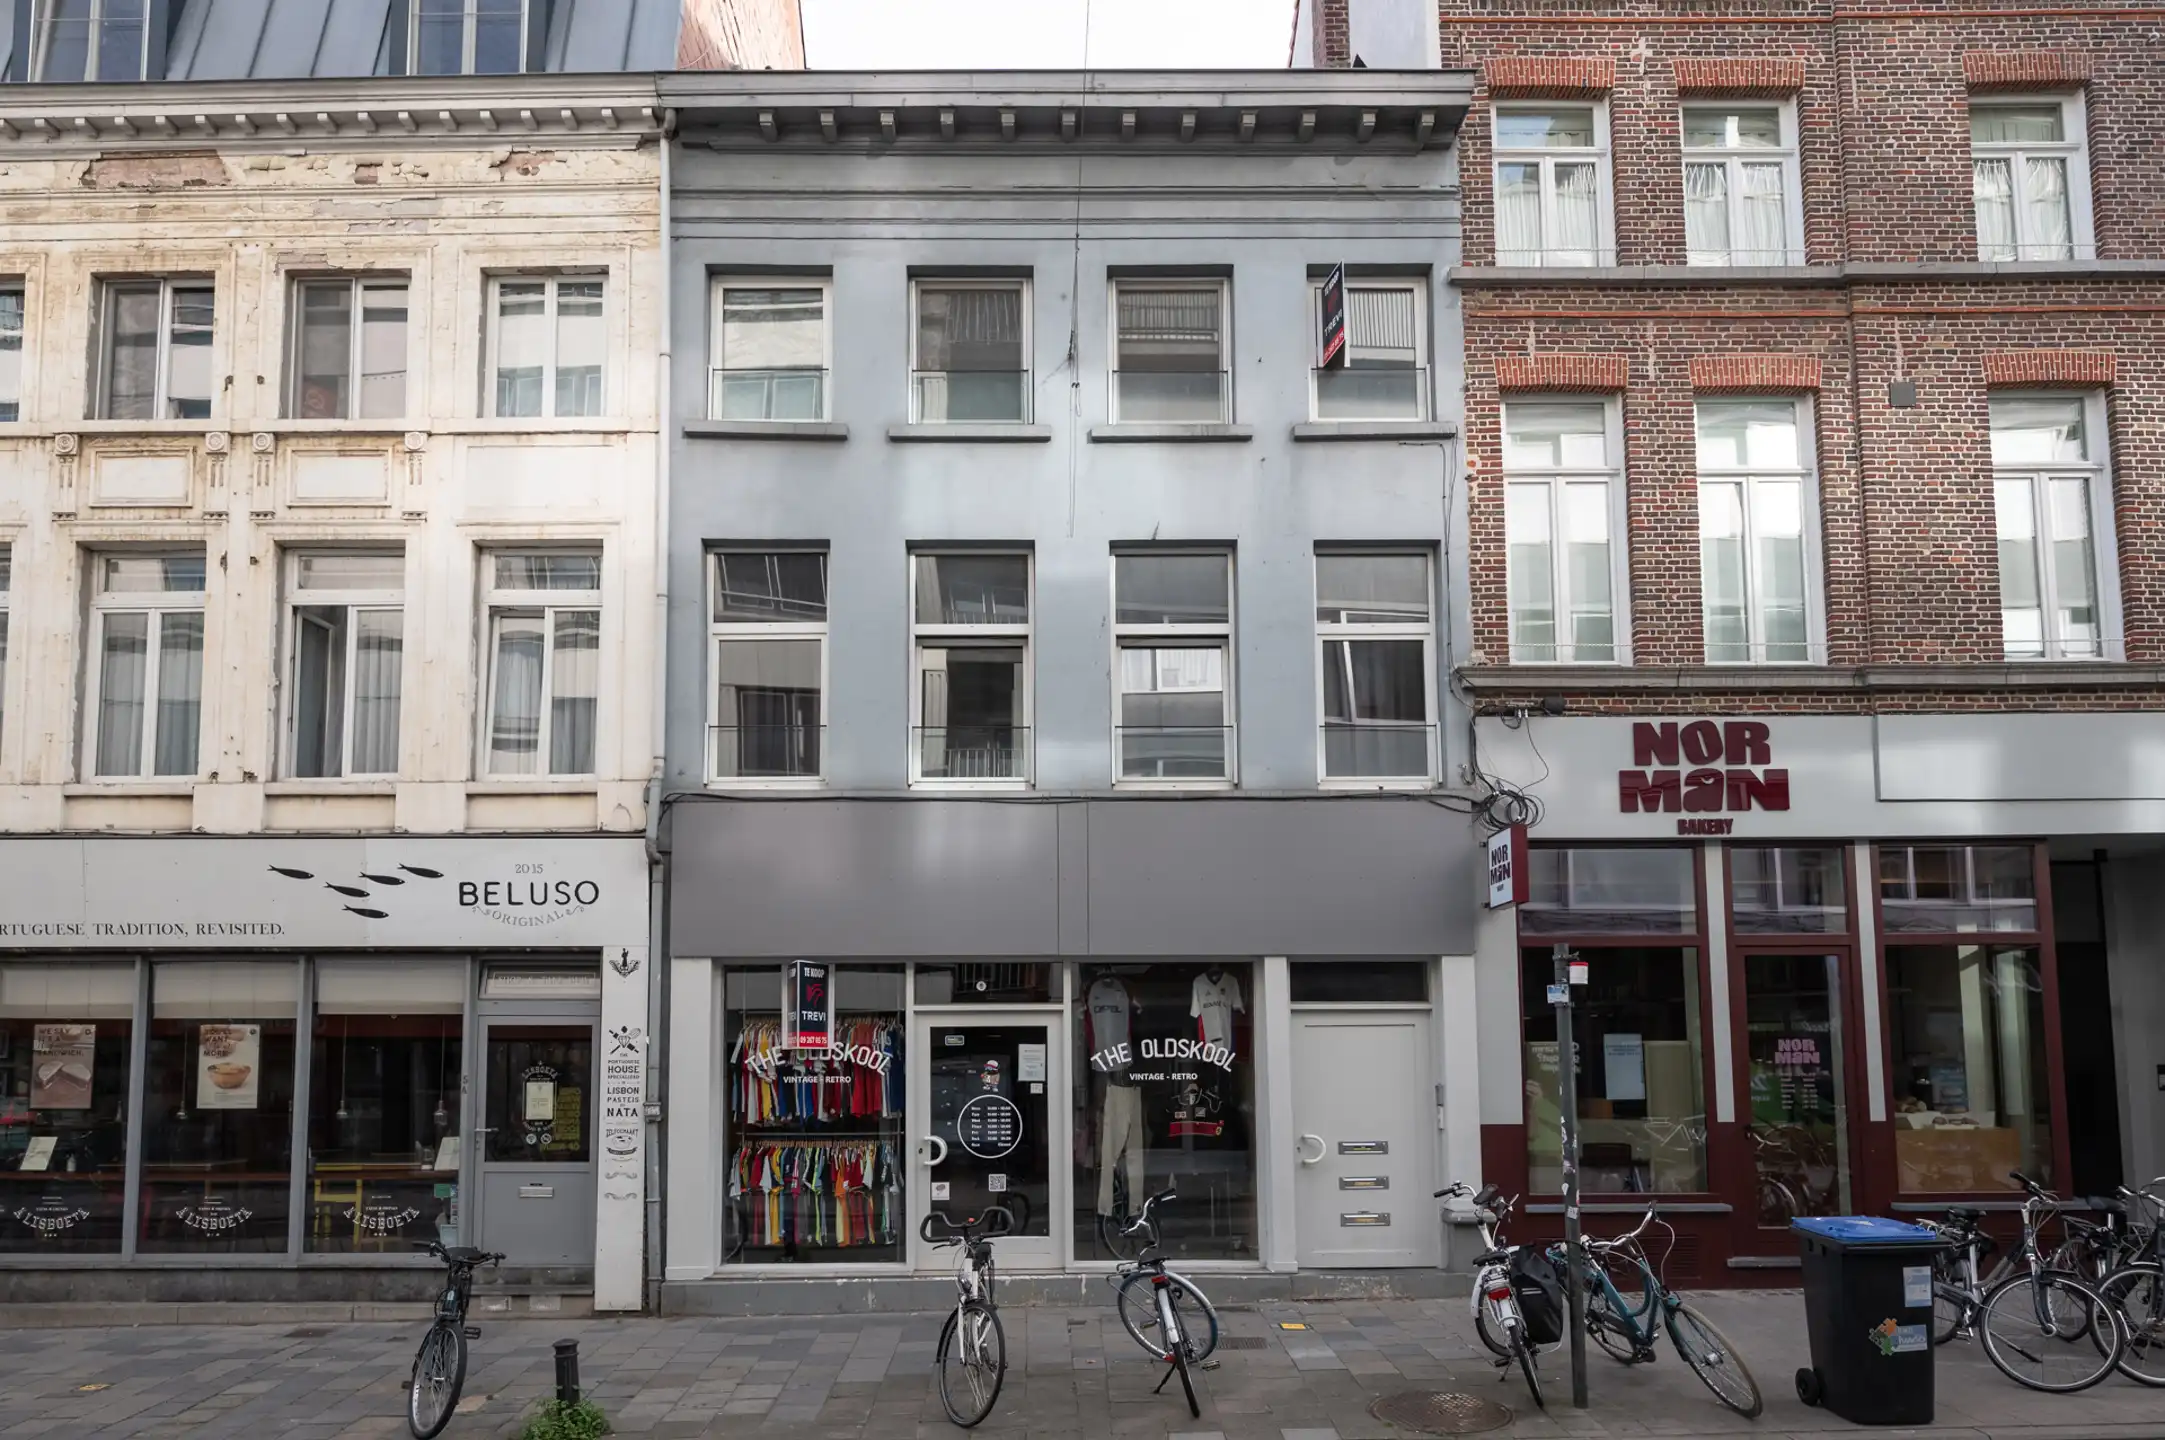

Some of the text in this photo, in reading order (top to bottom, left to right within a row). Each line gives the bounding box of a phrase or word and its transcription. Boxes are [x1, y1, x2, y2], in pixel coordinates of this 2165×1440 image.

[1324, 308, 1342, 336] TREVI
[1633, 720, 1771, 766] NOR
[1677, 818, 1733, 835] BAKERY
[1491, 844, 1508, 867] NOR
[515, 863, 544, 874] 2015
[458, 880, 600, 906] BELUSO
[492, 909, 564, 927] ORIGINAL
[93, 923, 189, 938] TRADITION,
[196, 923, 285, 936] REVISITED.
[804, 967, 810, 977] TE
[811, 968, 824, 978] KOOP
[802, 1010, 826, 1022] TREVI
[1094, 1005, 1122, 1013] OPEL
[1778, 1039, 1815, 1052] NOR
[745, 1042, 889, 1076] THE OLDSKOOL
[1090, 1038, 1236, 1072] THE OLDSKOOL
[783, 1076, 818, 1084] VINTAGE
[825, 1076, 851, 1084] RETRO
[607, 1108, 638, 1116] NATA
